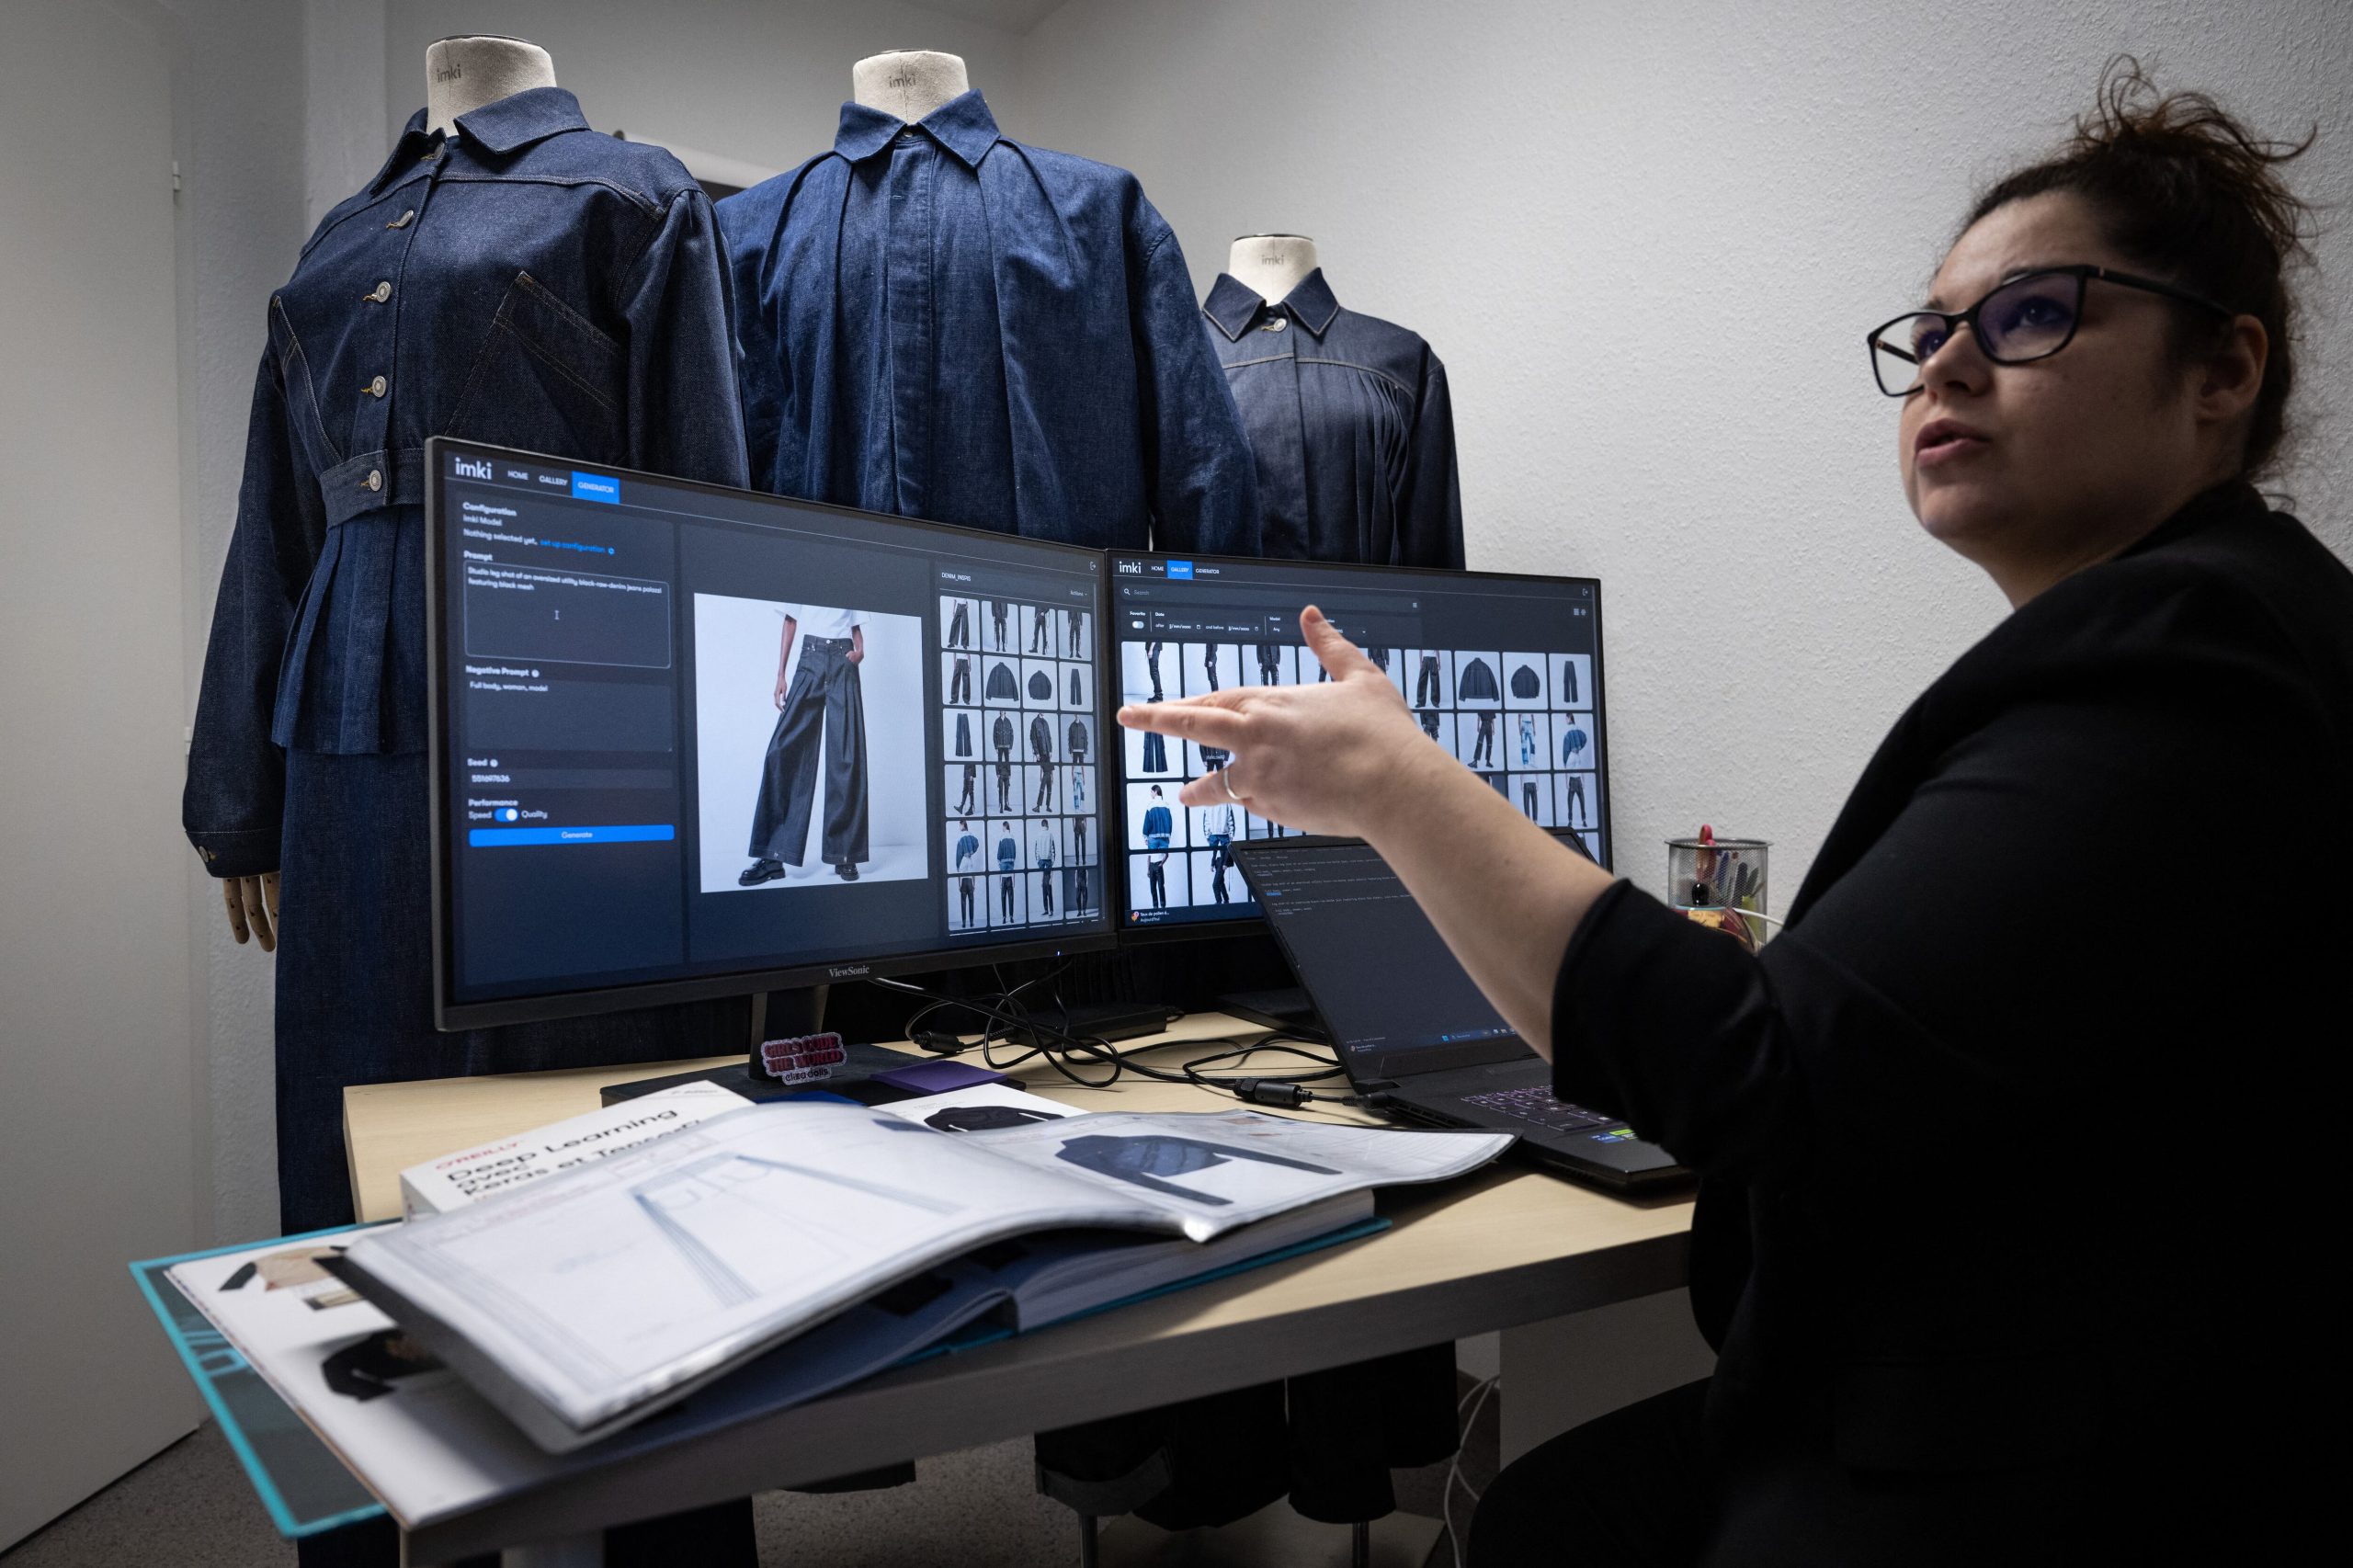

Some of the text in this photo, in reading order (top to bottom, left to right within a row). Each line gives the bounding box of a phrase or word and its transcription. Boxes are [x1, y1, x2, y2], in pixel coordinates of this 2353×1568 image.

[437, 63, 461, 83] imki
[889, 73, 916, 88] imki
[1261, 255, 1284, 265] imki
[455, 457, 492, 480] imki
[507, 470, 615, 494] HOME GALLERY GENERATOR
[462, 501, 517, 517] Configuration
[480, 517, 502, 527] Model
[463, 528, 493, 540] Nothing
[494, 533, 522, 543] selected
[562, 541, 606, 553] configuration
[464, 550, 493, 562] Prompt
[1119, 561, 1142, 574] imki
[465, 665, 529, 676] Negative Prompt
[467, 758, 488, 767] Seed
[468, 798, 518, 807] Performance
[469, 810, 549, 820] Speed Quality
[561, 830, 594, 839] Generate
[828, 965, 870, 978] ViewSonic
[447, 1109, 678, 1182] Deep Learning
[456, 1163, 529, 1190] avec
[463, 1168, 549, 1195] Keras
